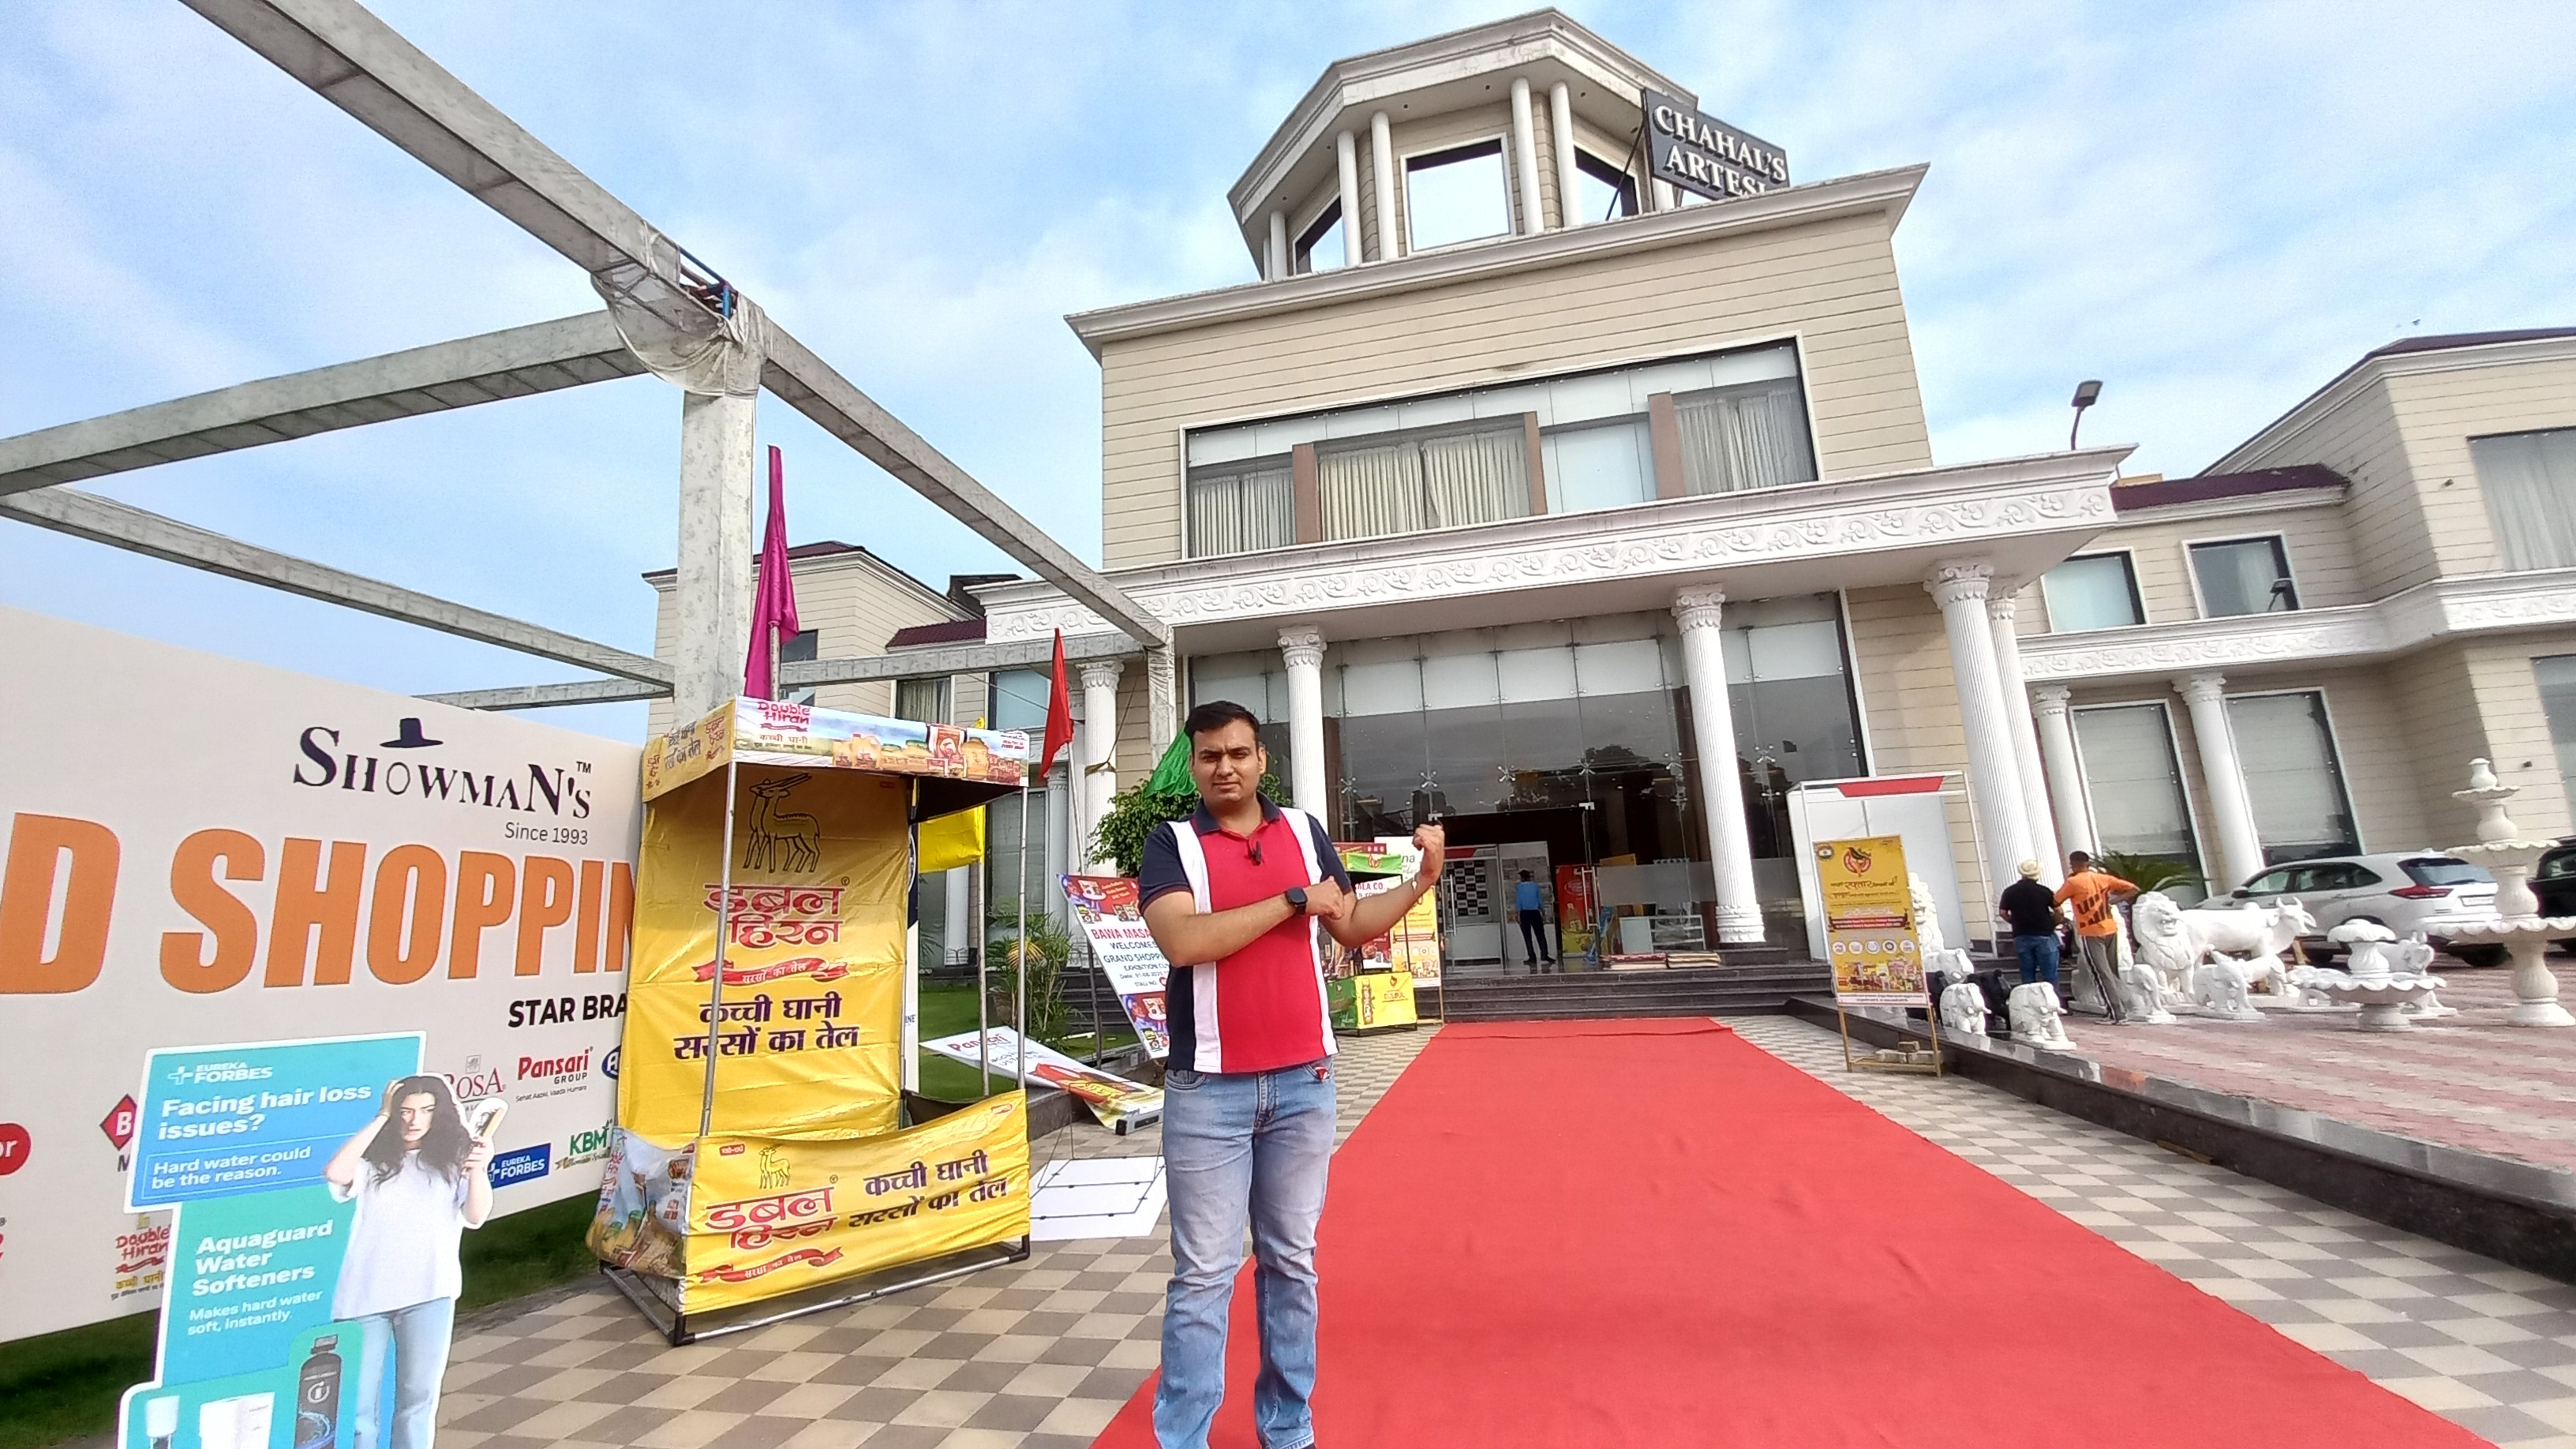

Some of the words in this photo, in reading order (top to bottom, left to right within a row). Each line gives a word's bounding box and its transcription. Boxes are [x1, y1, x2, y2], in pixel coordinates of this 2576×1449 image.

[1653, 105, 1787, 182] CHAHAL'S
[758, 702, 811, 716] Double
[763, 711, 809, 725] Hiran
[294, 726, 590, 819] SHOWMAN'S
[504, 822, 549, 842] Since
[552, 827, 589, 845] 1993
[703, 883, 845, 915] डबल
[727, 913, 844, 948] हिरन
[1091, 928, 1123, 939] BAWA
[1103, 953, 1134, 964] GRAND
[507, 996, 576, 1028] STAR
[782, 990, 843, 1020] घानी
[768, 1029, 807, 1052] का
[815, 1020, 860, 1049] तेल
[194, 1066, 274, 1084] FORBES
[197, 1061, 248, 1072] EUREKA
[518, 1048, 590, 1081] Pansari
[554, 1072, 588, 1084] GROUP
[161, 1094, 257, 1118] Facing
[260, 1088, 315, 1110] hair
[319, 1086, 372, 1103] loss
[158, 1114, 266, 1140] issues?
[569, 1129, 608, 1156] KBM
[153, 1158, 200, 1176] Hard
[204, 1155, 257, 1170] water
[260, 1146, 312, 1163] could
[500, 1159, 545, 1180] FORBES
[501, 1155, 531, 1167] EUREKA
[863, 1160, 927, 1196] कच्ची
[934, 1149, 988, 1181] घानी
[152, 1176, 175, 1189] be
[179, 1171, 211, 1186] the
[215, 1166, 283, 1184] reason.
[705, 1186, 835, 1230] डबल
[115, 1226, 169, 1249] Double
[196, 1219, 334, 1256] Aquaguard
[196, 1252, 273, 1275] Water
[192, 1265, 316, 1297] Softeners
[189, 1305, 239, 1321] Makes
[242, 1296, 277, 1313] hard
[279, 1290, 324, 1306] water
[188, 1321, 222, 1336] soft,
